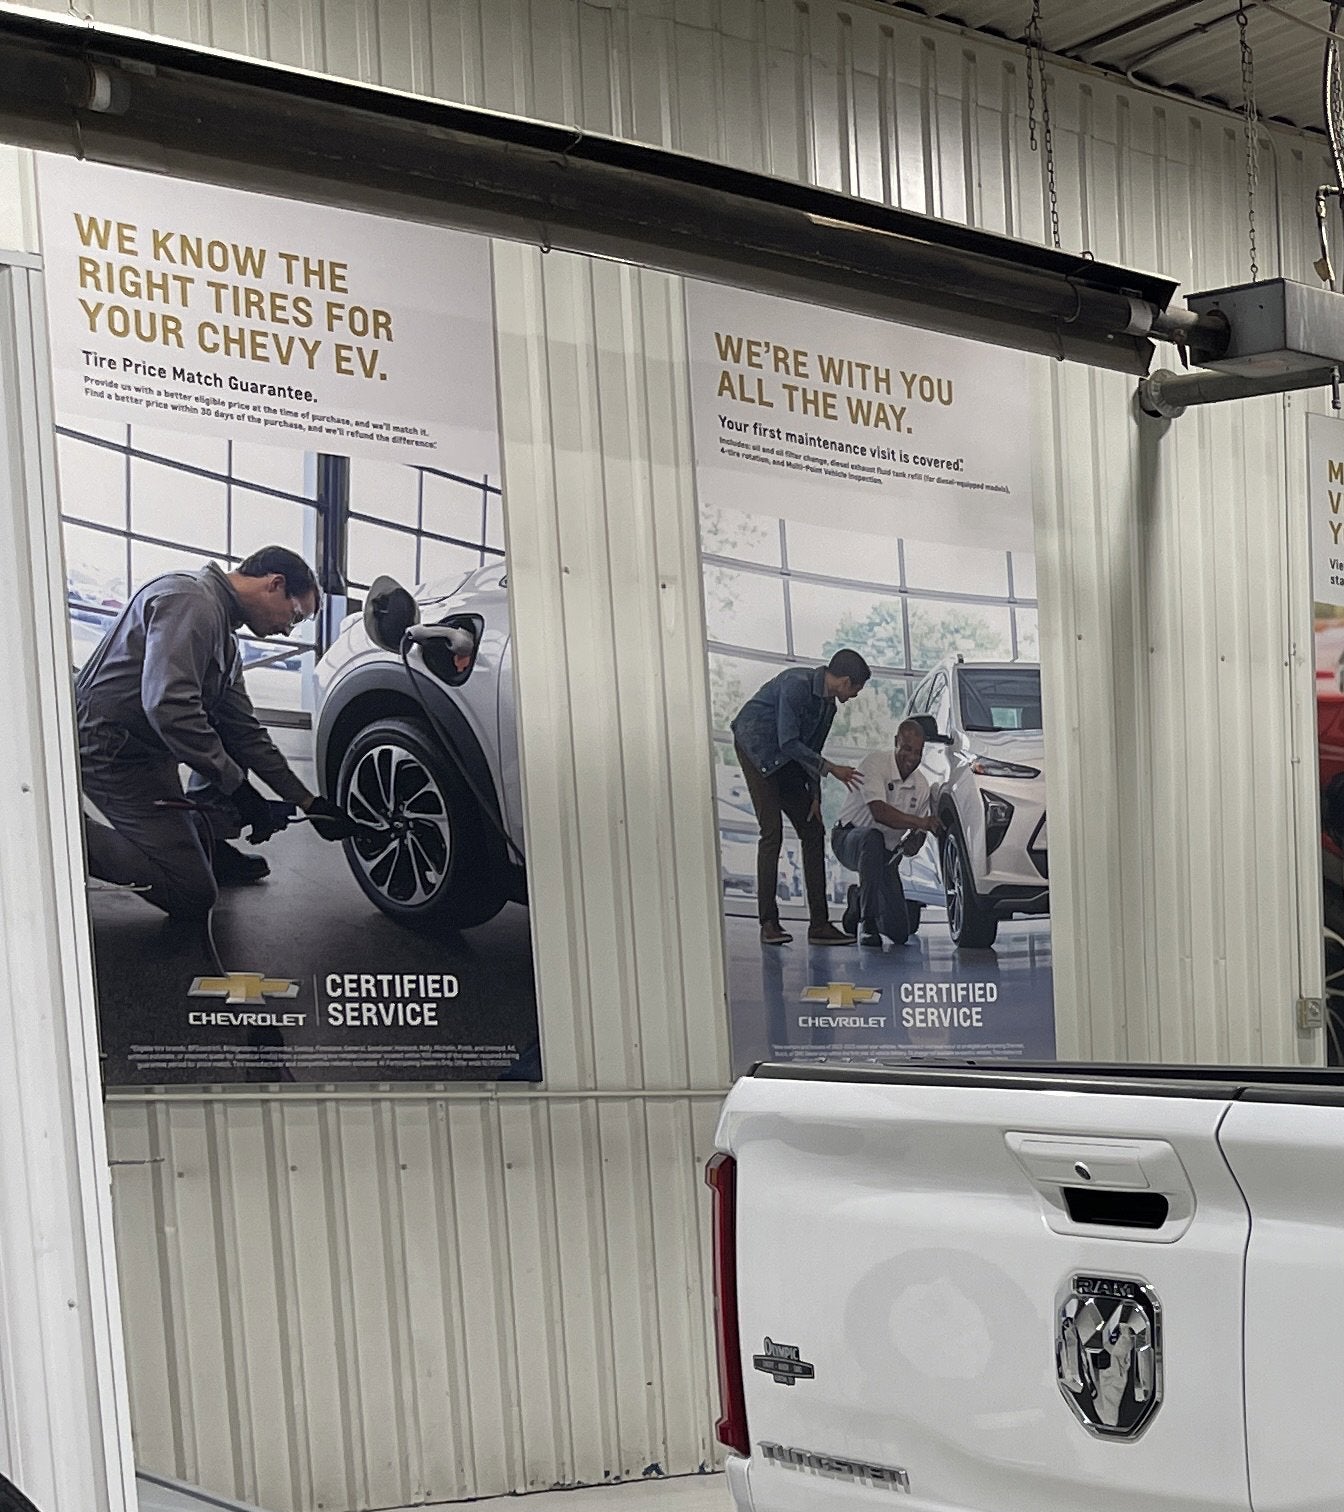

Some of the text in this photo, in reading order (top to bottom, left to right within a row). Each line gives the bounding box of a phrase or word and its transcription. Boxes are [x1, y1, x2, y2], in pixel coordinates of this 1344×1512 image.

[74, 213, 348, 294] WE KNOW THE
[79, 256, 393, 342] RIGHT TIRES FOR
[78, 298, 388, 381] YOUR CHEVY EV.
[82, 350, 318, 403] Tire Price Match Guarantee.
[714, 332, 953, 405] WE'RE WITH YOU
[717, 369, 913, 435] ALL THE WAY.
[718, 414, 749, 433] Your
[753, 422, 782, 441] first
[785, 431, 867, 456] maintenance
[870, 445, 896, 462] visit
[900, 449, 910, 464] is
[325, 973, 459, 999] CERTIFIED
[900, 982, 997, 1004] CERTIFIED
[188, 1011, 306, 1027] CHEVROLET
[328, 1002, 439, 1027] SERVICE
[798, 1016, 886, 1028] CHEVROLET
[901, 1007, 983, 1028] SERVICE
[1077, 1279, 1135, 1298] RAM
